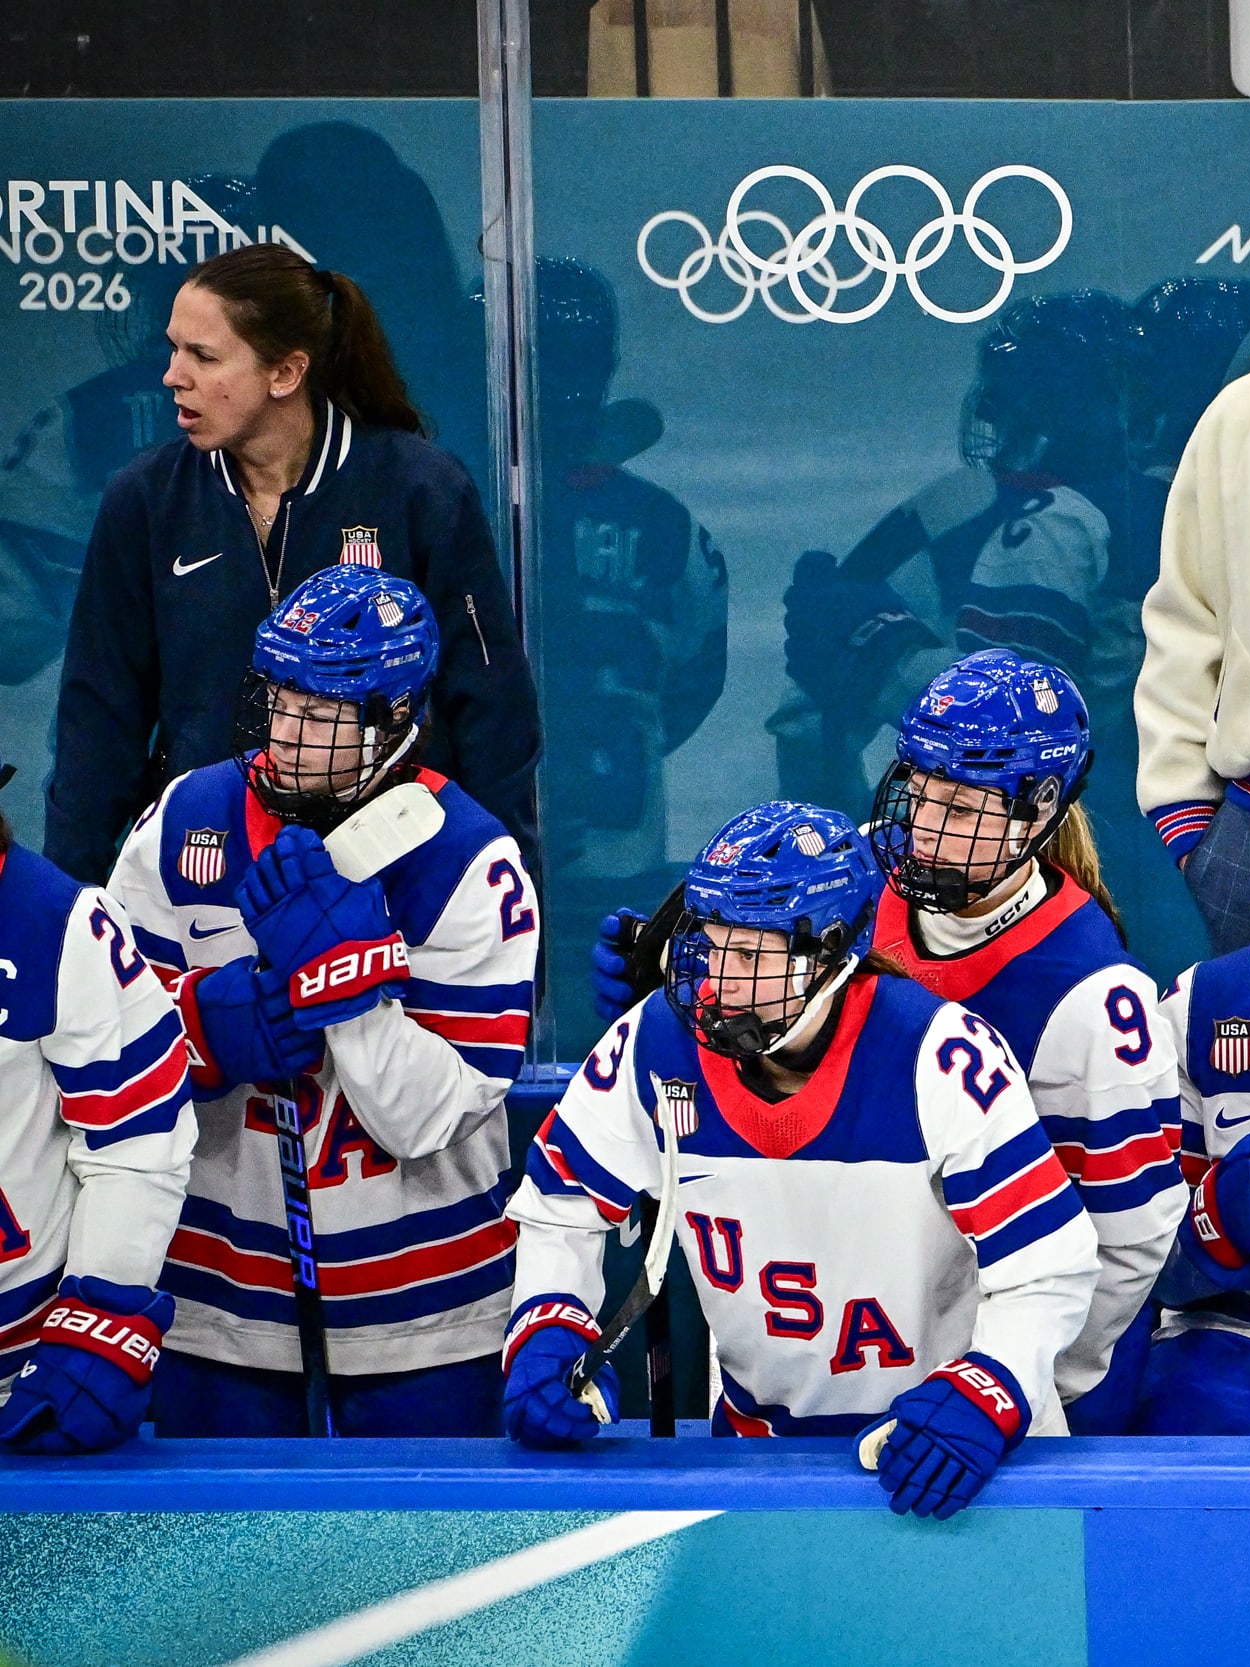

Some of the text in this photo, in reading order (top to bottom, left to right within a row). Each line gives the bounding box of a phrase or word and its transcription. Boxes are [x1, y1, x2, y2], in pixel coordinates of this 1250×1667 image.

[0, 180, 237, 233] RTINA
[19, 272, 131, 312] 2026
[1040, 743, 1077, 760] CCM
[191, 833, 219, 846] USA
[985, 891, 1029, 938] CCM
[1104, 984, 1152, 1067] 9
[1220, 1024, 1248, 1037] USA
[664, 1085, 689, 1099] USA
[272, 1093, 318, 1291] BAUER
[685, 1210, 915, 1376] USA
[43, 1307, 160, 1374] BAUER
